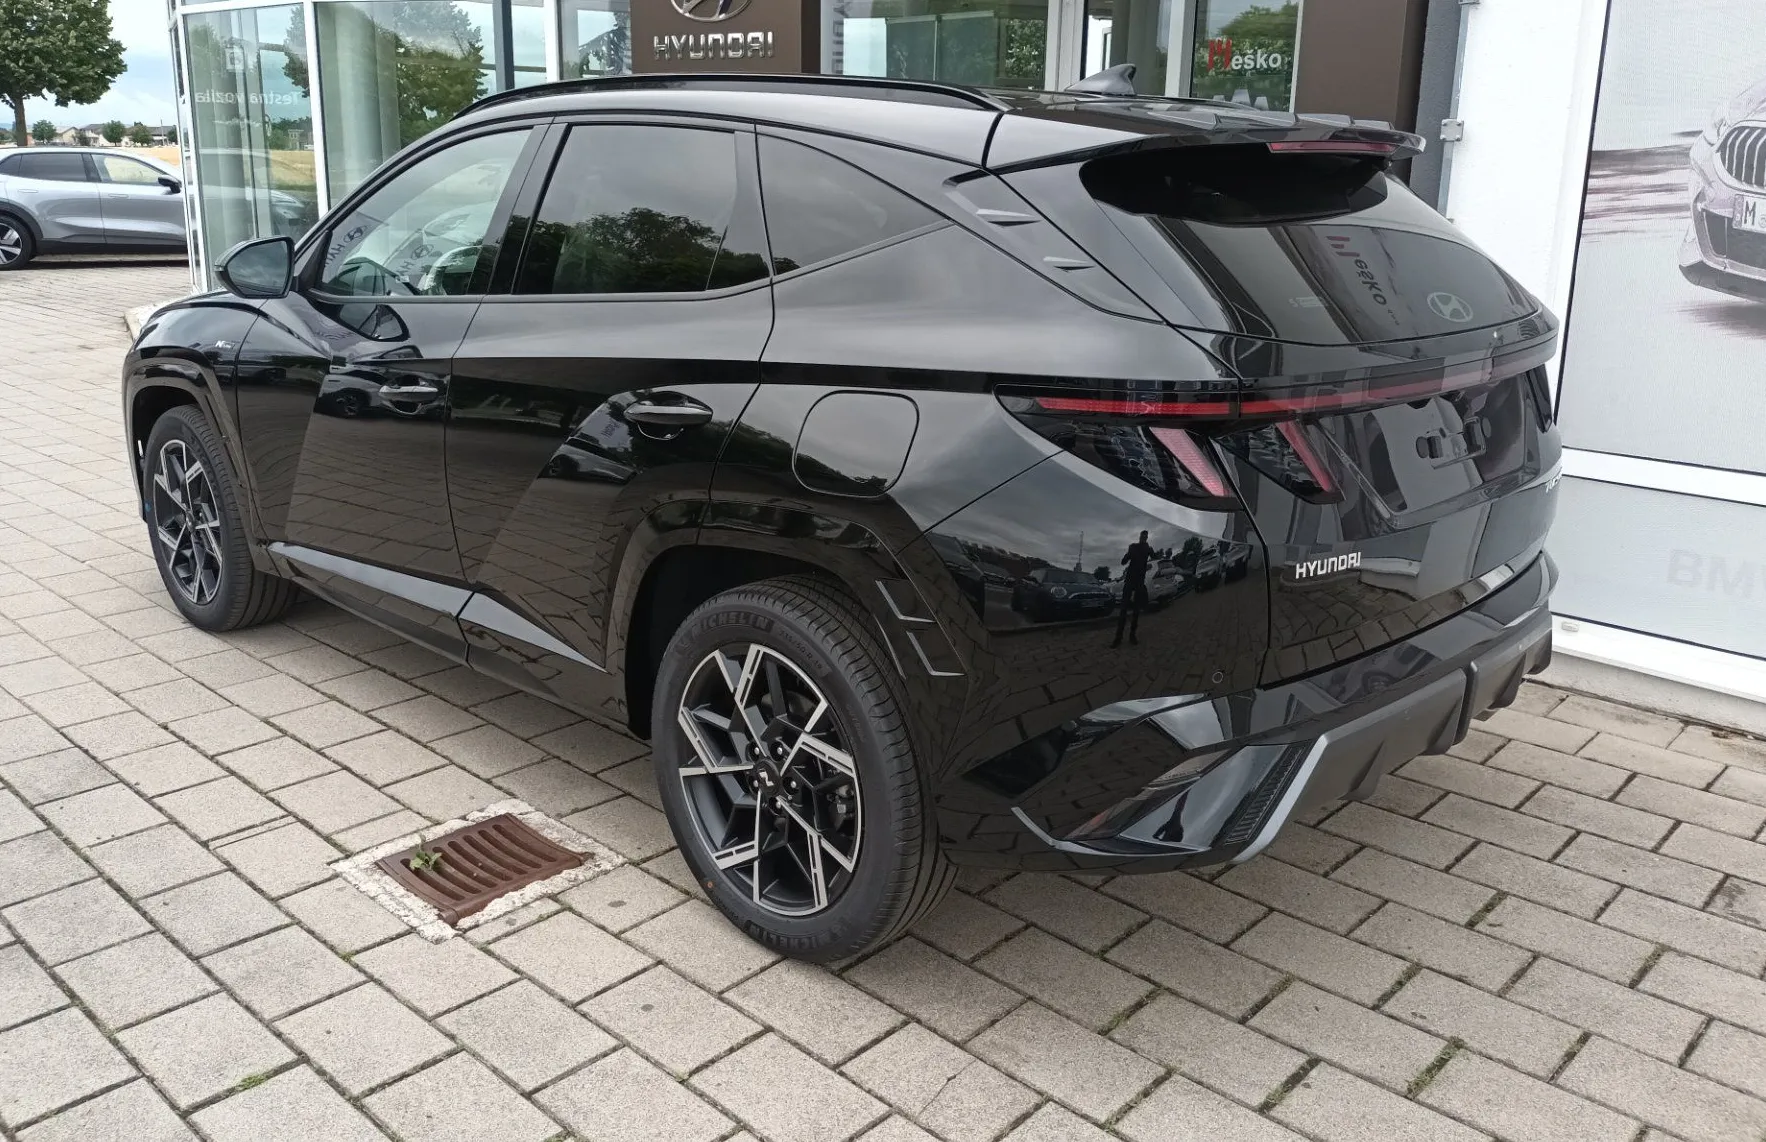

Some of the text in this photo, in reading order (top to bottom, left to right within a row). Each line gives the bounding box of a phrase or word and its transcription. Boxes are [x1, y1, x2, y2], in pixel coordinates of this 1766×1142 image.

[653, 31, 773, 60] HYUNDAI
[1206, 37, 1282, 71] Meško
[1295, 551, 1362, 579] HYUNDAI
